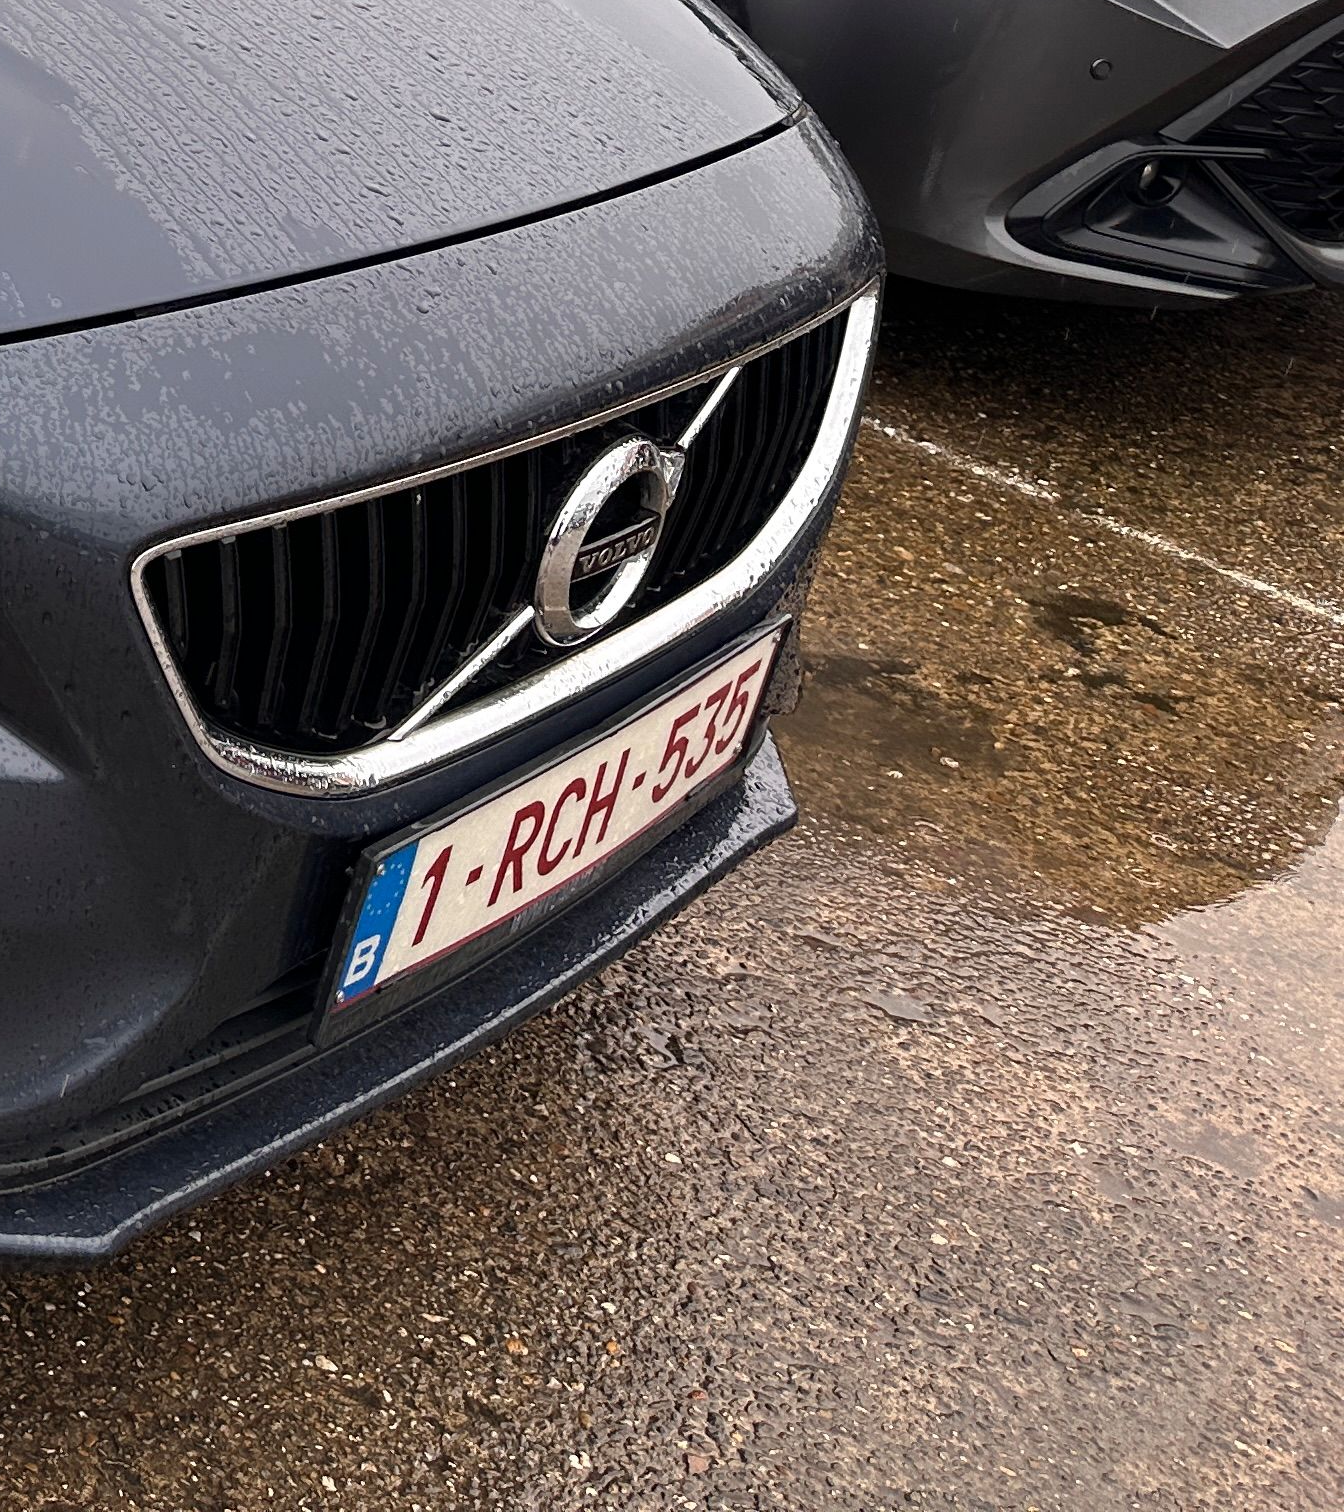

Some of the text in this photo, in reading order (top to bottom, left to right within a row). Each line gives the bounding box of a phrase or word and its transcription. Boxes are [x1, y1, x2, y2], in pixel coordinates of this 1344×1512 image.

[578, 527, 656, 574] VOLVO
[412, 660, 762, 947] 1-RCH-535
[343, 934, 381, 987] B
